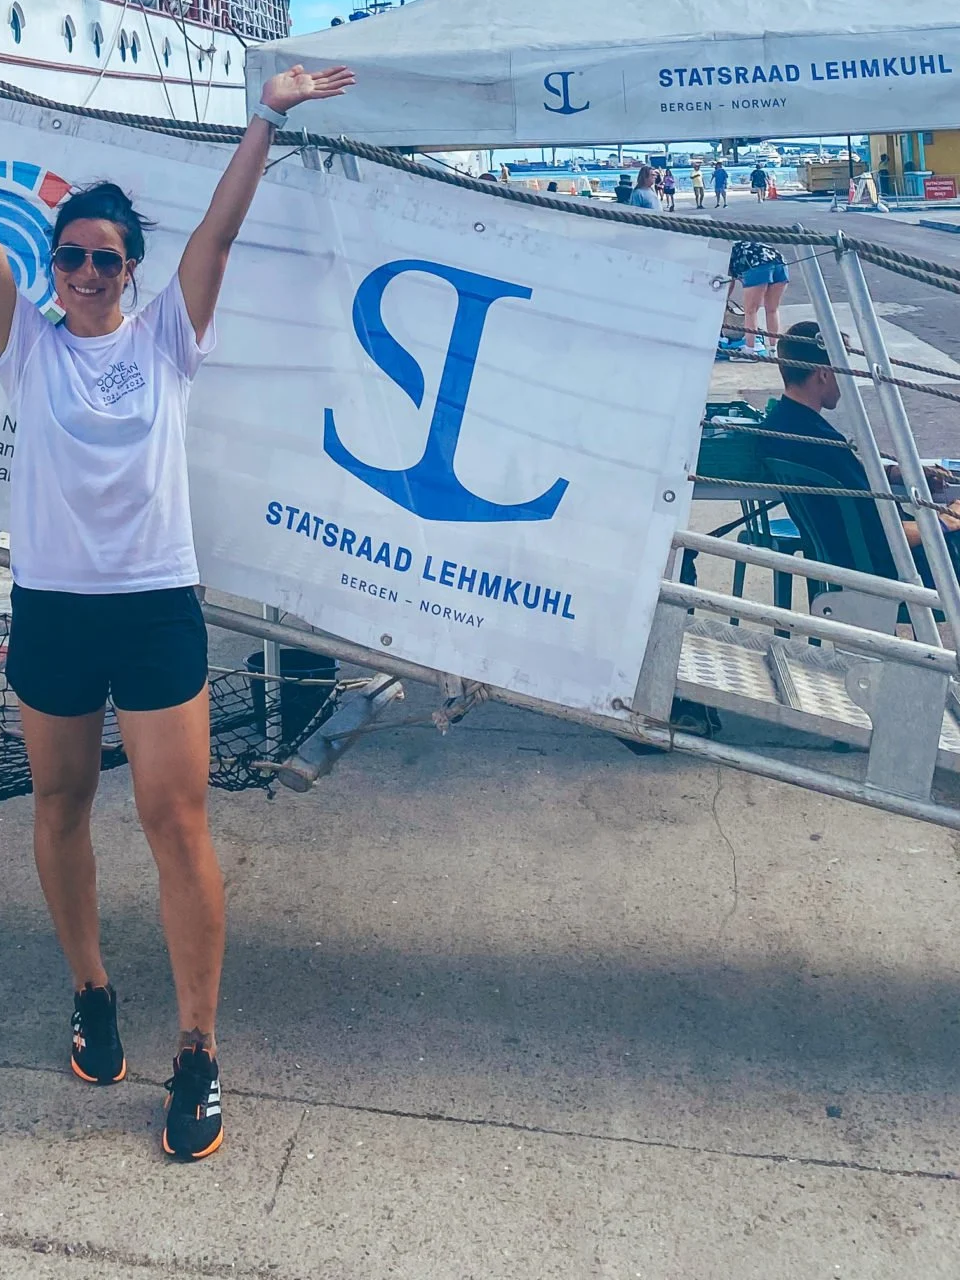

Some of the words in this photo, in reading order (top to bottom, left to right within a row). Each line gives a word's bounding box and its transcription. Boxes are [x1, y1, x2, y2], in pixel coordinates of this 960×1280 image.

[659, 64, 800, 87] STATSRAAD
[811, 54, 952, 81] LEHMKUHL
[660, 101, 712, 112] BERGEN
[732, 98, 787, 110] NORWAY
[266, 501, 412, 572] STATSRAAD
[422, 555, 576, 620] LEHMKUHL
[341, 573, 398, 603] BERGEN
[419, 600, 484, 628] NORWAY
